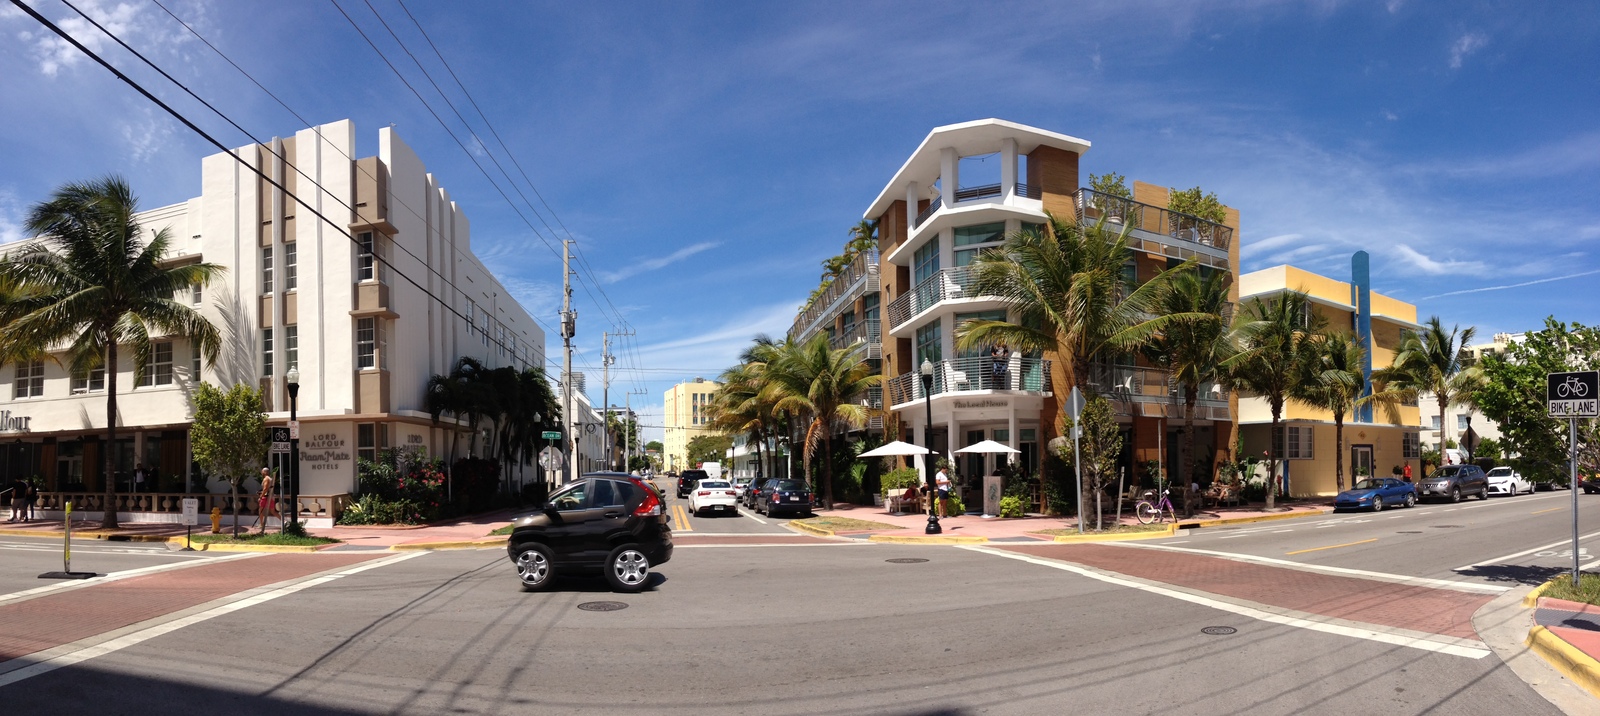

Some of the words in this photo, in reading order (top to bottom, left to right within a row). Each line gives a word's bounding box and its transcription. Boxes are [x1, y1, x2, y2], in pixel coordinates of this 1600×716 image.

[1551, 402, 1569, 413] BIKE
[1573, 401, 1595, 413] LANE
[313, 433, 337, 441] LORD
[305, 440, 345, 448] BALFOUR
